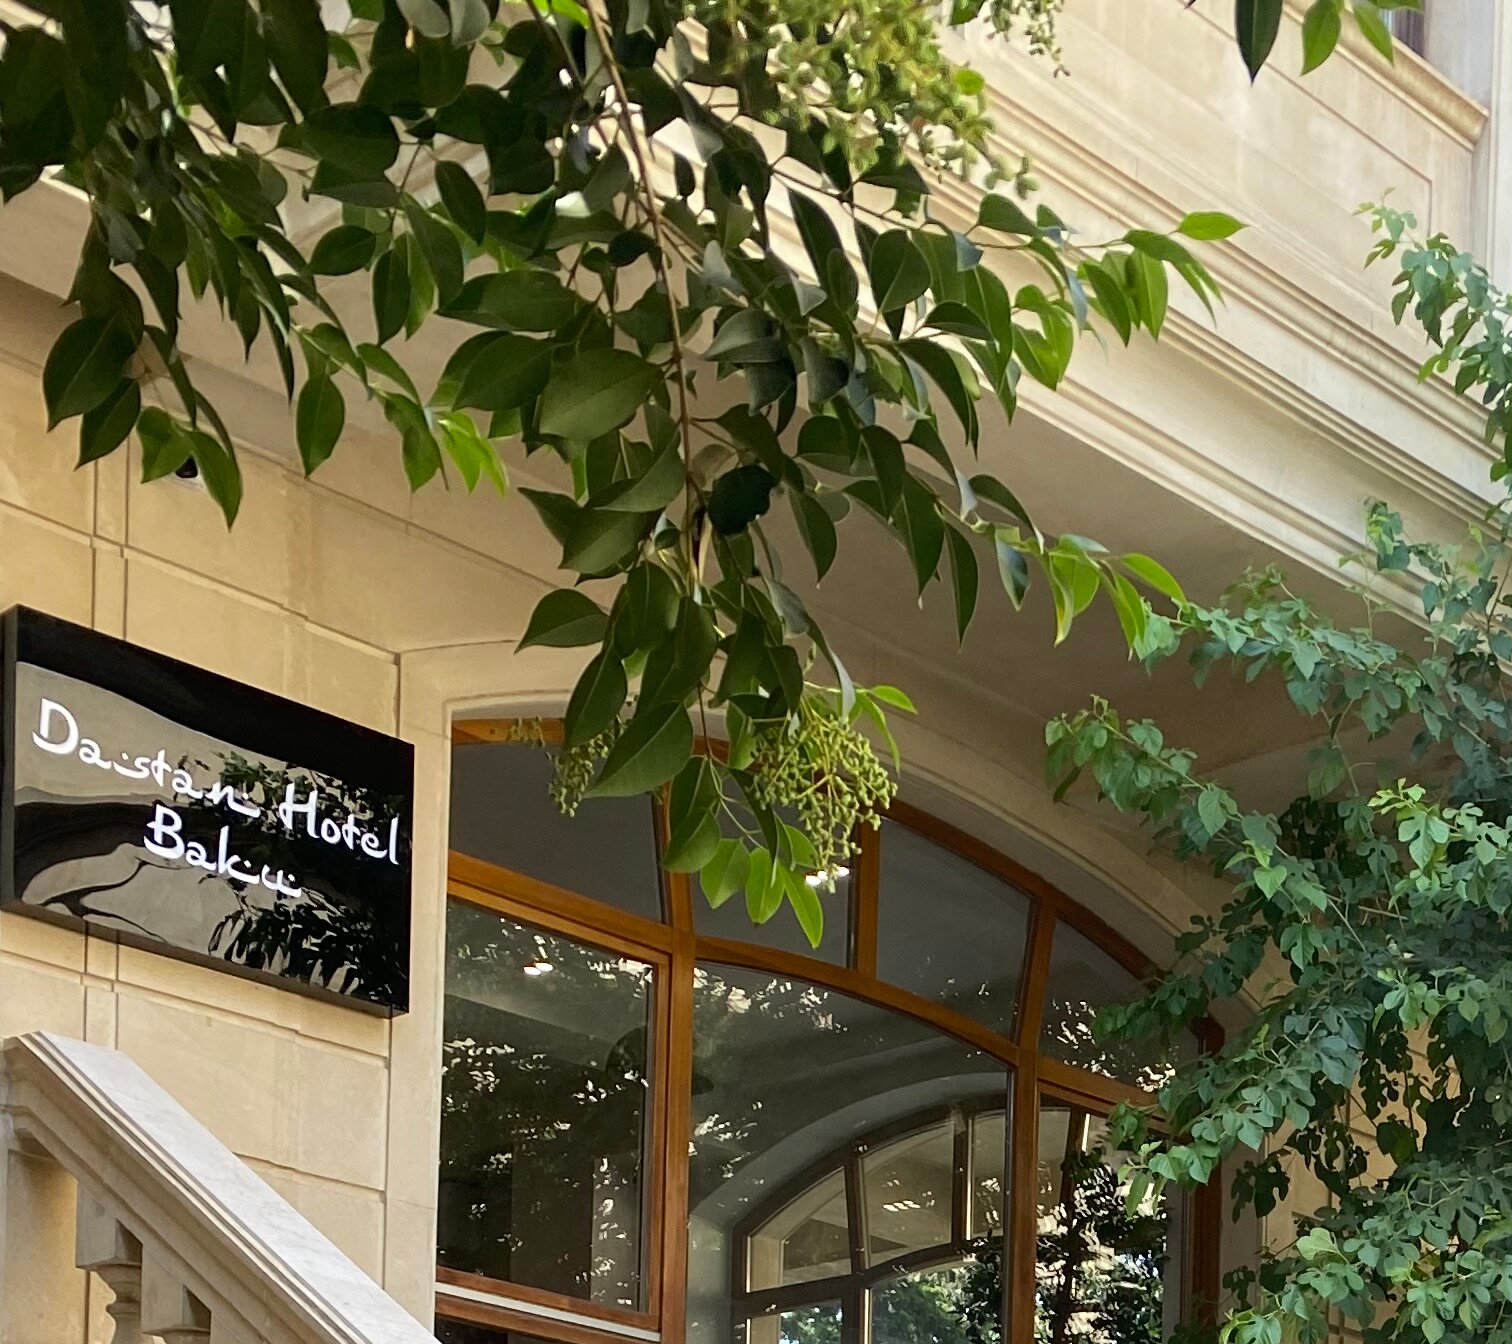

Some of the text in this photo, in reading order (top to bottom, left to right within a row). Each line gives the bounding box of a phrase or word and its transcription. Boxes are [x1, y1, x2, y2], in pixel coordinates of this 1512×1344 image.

[32, 697, 400, 866] Dastan Hotel
[144, 804, 302, 898] Baku
